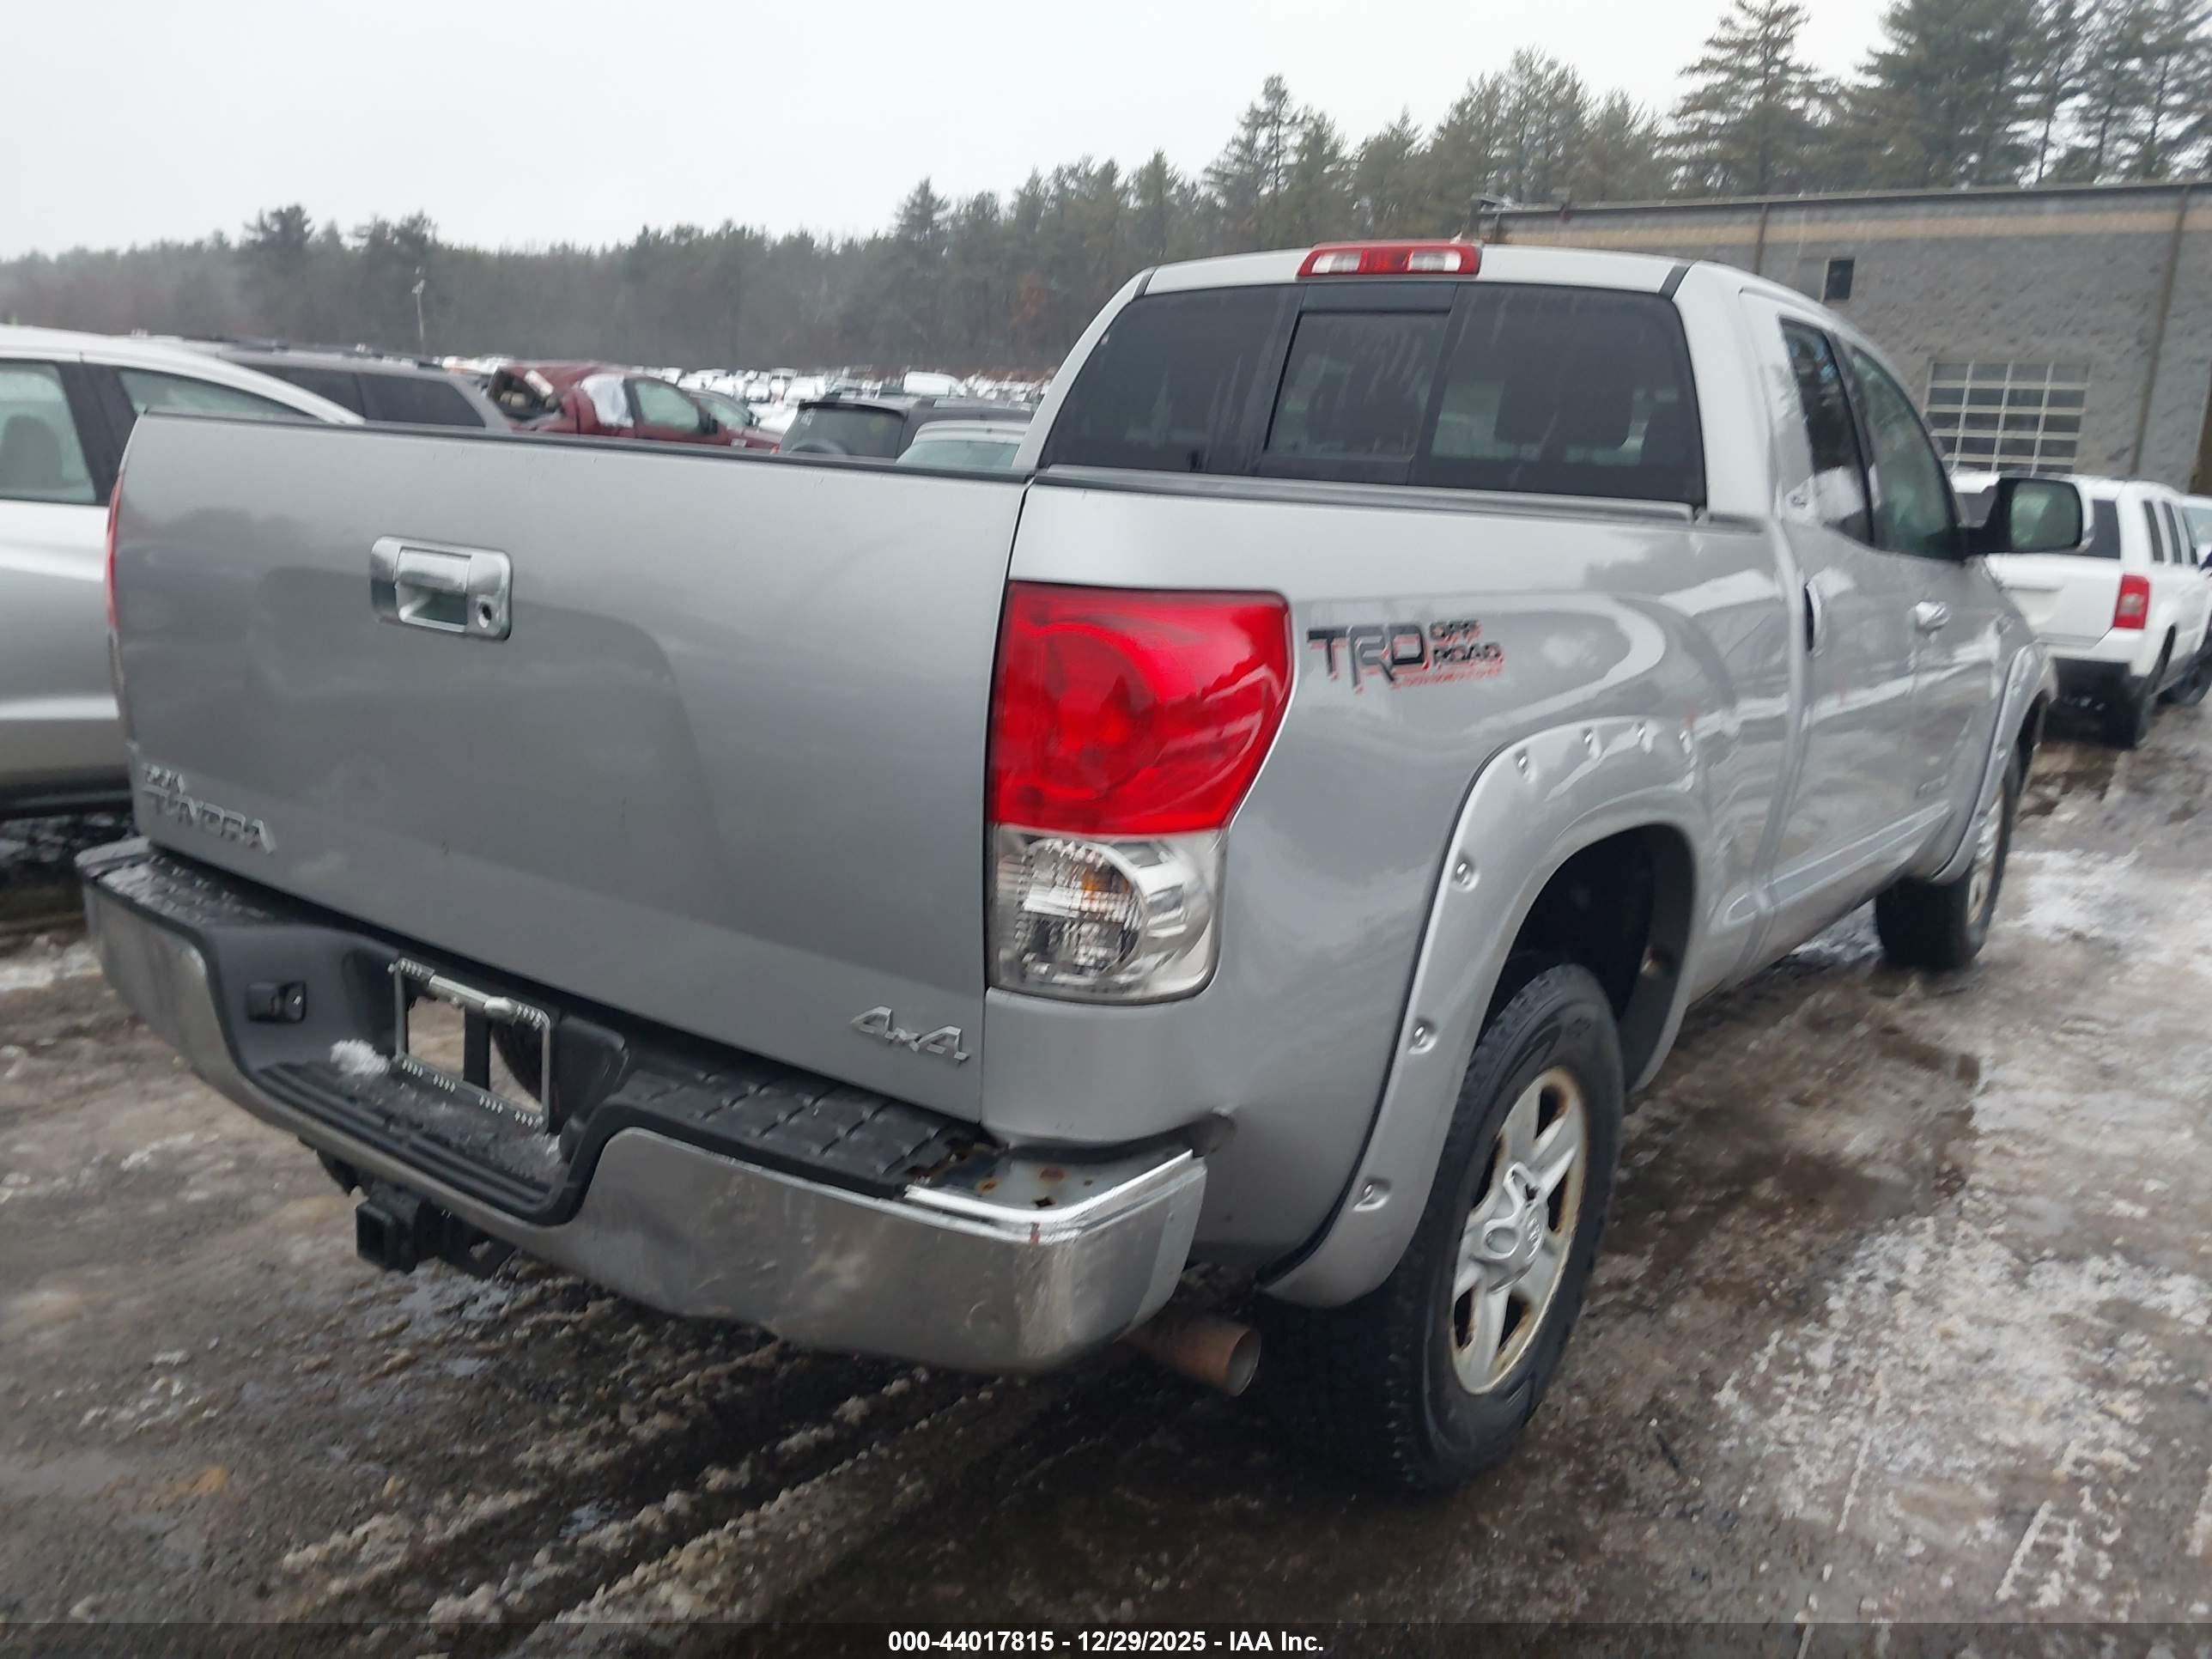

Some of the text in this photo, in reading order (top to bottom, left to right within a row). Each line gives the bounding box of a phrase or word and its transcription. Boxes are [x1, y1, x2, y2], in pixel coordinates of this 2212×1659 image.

[1429, 619, 1482, 642] OFF
[1432, 641, 1504, 665] ROAD
[1307, 624, 1426, 692] TRD
[143, 783, 276, 854] TUNDRA
